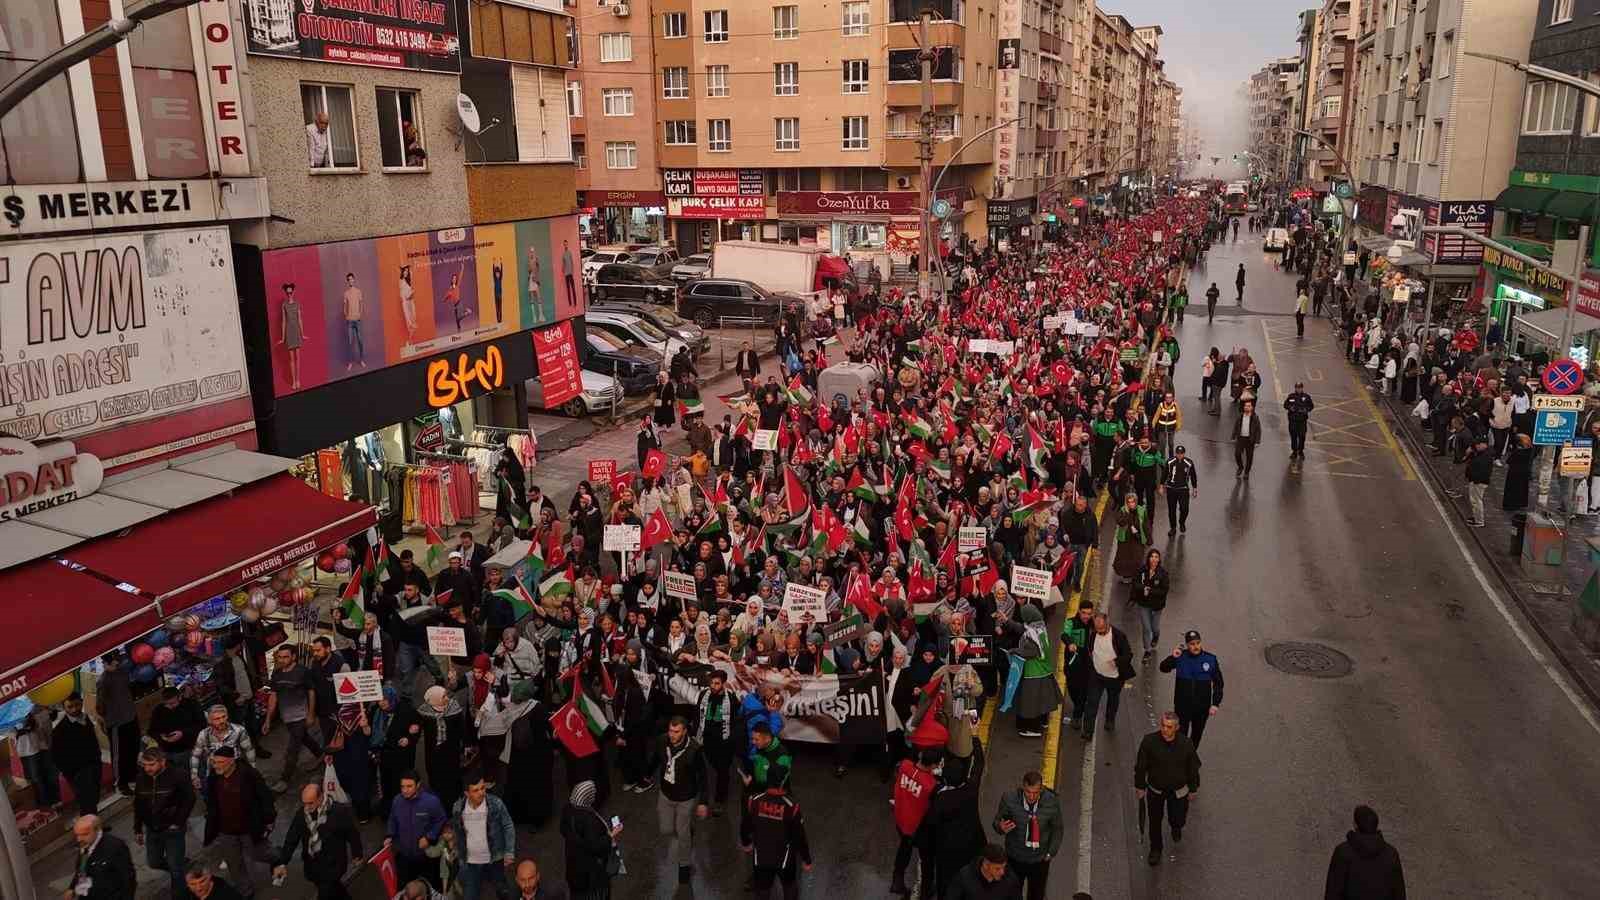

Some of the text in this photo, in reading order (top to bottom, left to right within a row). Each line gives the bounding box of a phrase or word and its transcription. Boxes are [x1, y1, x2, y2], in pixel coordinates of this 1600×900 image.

[205, 0, 244, 155] OTER
[665, 170, 692, 182] ÇELİK
[668, 183, 690, 194] KAPI
[38, 183, 192, 220] MERKEZİ
[682, 197, 763, 209] BURÇ ÇELİK KAPI
[1449, 204, 1486, 216] KLAS
[1456, 214, 1479, 223] AVM
[241, 539, 318, 581] ALIŞVERİŞ MERKEZİ
